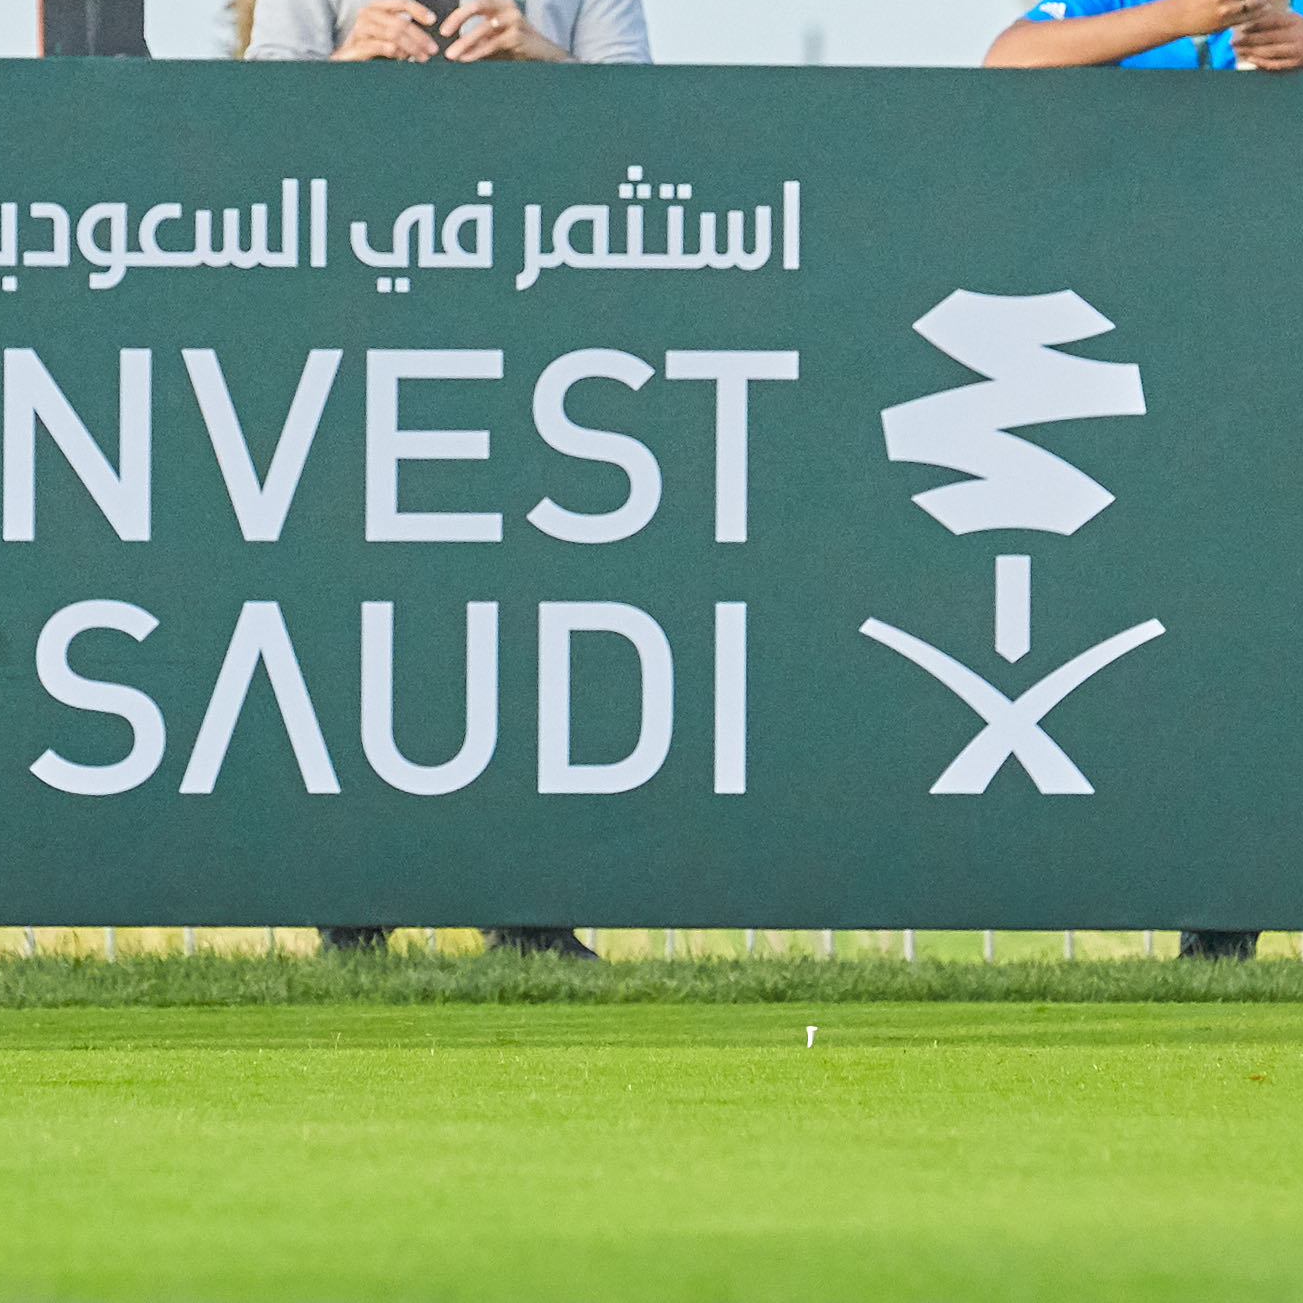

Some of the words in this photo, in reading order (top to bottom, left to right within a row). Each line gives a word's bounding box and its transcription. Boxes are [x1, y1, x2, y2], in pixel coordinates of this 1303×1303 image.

[350, 180, 495, 293] في
[516, 165, 801, 291] استثمر
[29, 599, 747, 796] SAUDI
